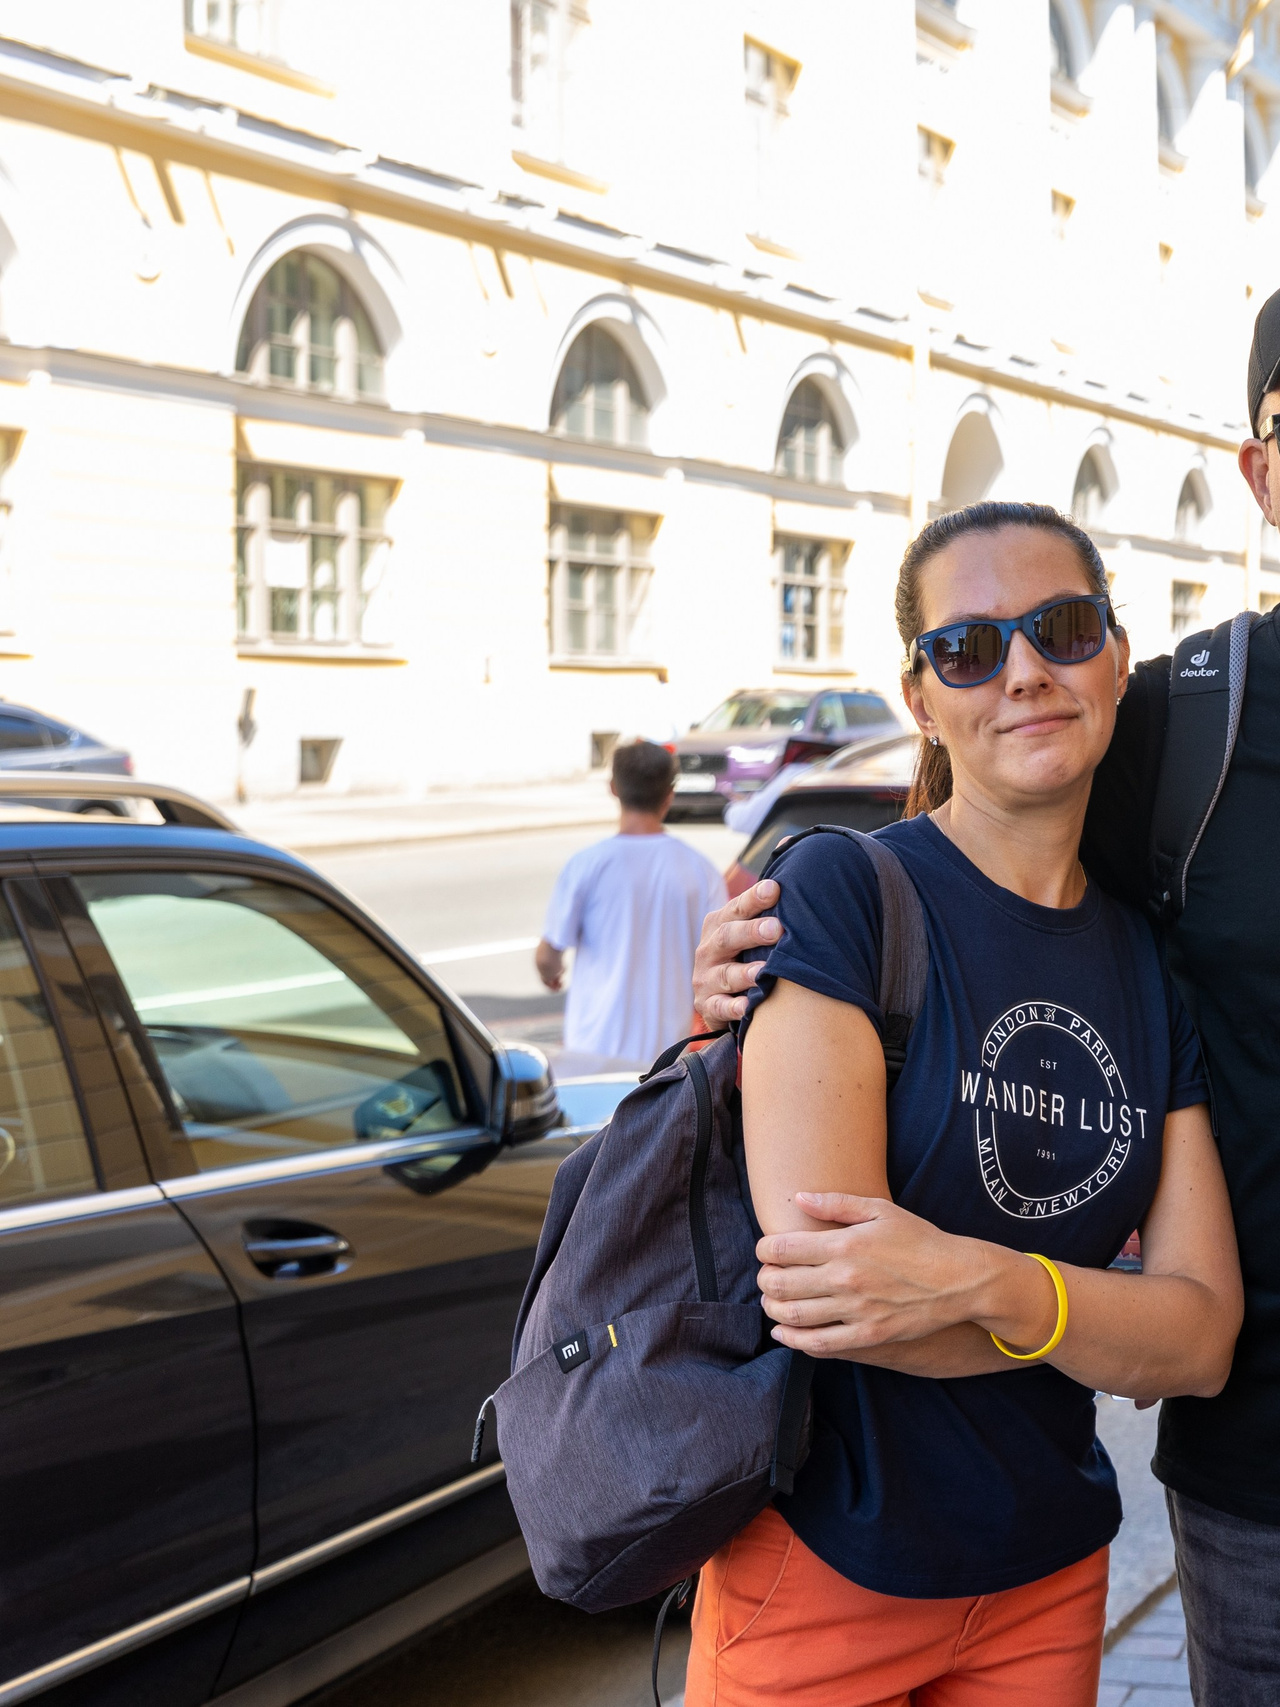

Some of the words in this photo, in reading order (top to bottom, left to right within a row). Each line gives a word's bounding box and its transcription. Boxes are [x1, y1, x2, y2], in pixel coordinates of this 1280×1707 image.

[1180, 668, 1219, 677] deuter
[983, 1006, 1038, 1068] LONDON
[1069, 1018, 1115, 1077] PARIS
[1040, 1059, 1057, 1070] EST
[961, 1069, 1064, 1127] WANDER
[1080, 1098, 1147, 1139] LUST
[979, 1137, 1008, 1202] MILAN
